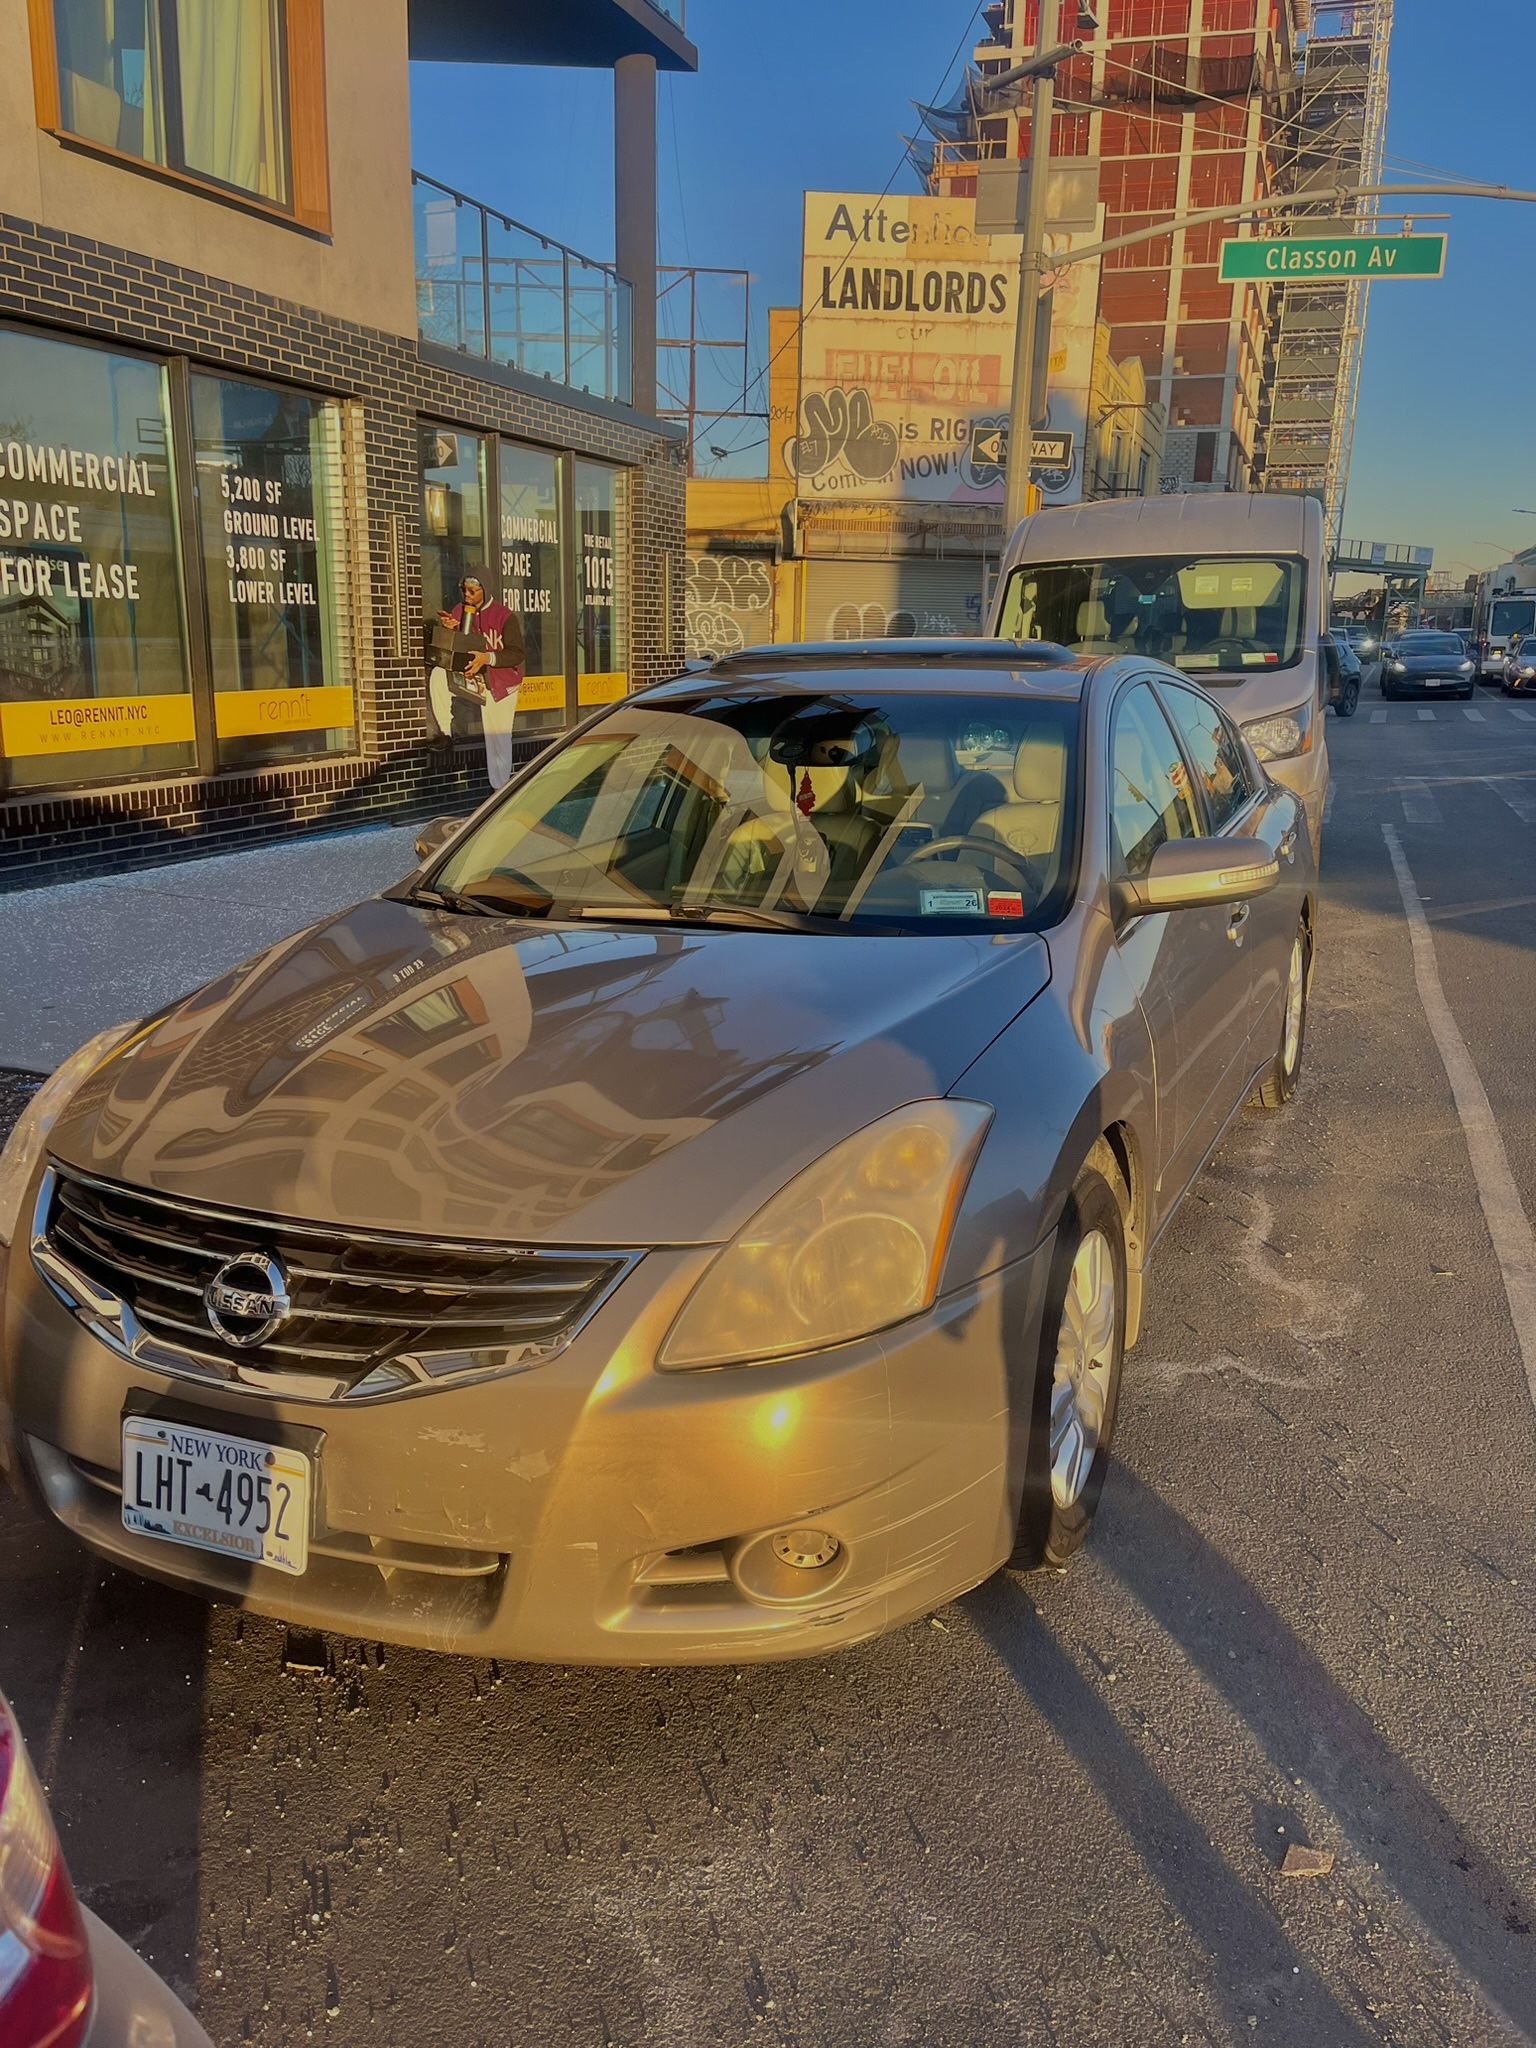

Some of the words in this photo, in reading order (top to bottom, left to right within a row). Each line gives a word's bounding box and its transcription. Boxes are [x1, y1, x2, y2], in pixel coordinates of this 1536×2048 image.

[1265, 247, 1357, 270] Classon
[1367, 246, 1397, 268] Av
[821, 266, 1008, 314] LANDLORDS
[932, 357, 988, 403] OIL
[899, 417, 919, 440] is
[900, 452, 958, 480] NOW!
[221, 474, 261, 503] 5,200
[265, 480, 282, 504] SF
[812, 472, 867, 491] Com
[0, 498, 82, 543] SPACE
[223, 509, 279, 538] GROUND
[283, 516, 321, 542] LEVEL
[501, 514, 559, 544] COMMERCIAL
[226, 545, 265, 573] 3,800
[270, 549, 287, 571] SF
[502, 551, 532, 577] SPACE
[584, 555, 615, 590] 1015
[0, 557, 54, 596] FOR
[63, 561, 140, 600] LEASE
[229, 580, 275, 604] LOWER
[279, 582, 317, 605] LEVEL
[503, 588, 521, 612] FOR
[523, 589, 551, 613] LEASE
[50, 705, 148, 727] LEO@RENNIT.NYC
[258, 693, 312, 721] rennit
[170, 1434, 212, 1459] NEW
[215, 1444, 263, 1472] YORK
[136, 1451, 193, 1515] LHT
[216, 1469, 292, 1541] 4952
[172, 1519, 256, 1552] EXCELSIOR
